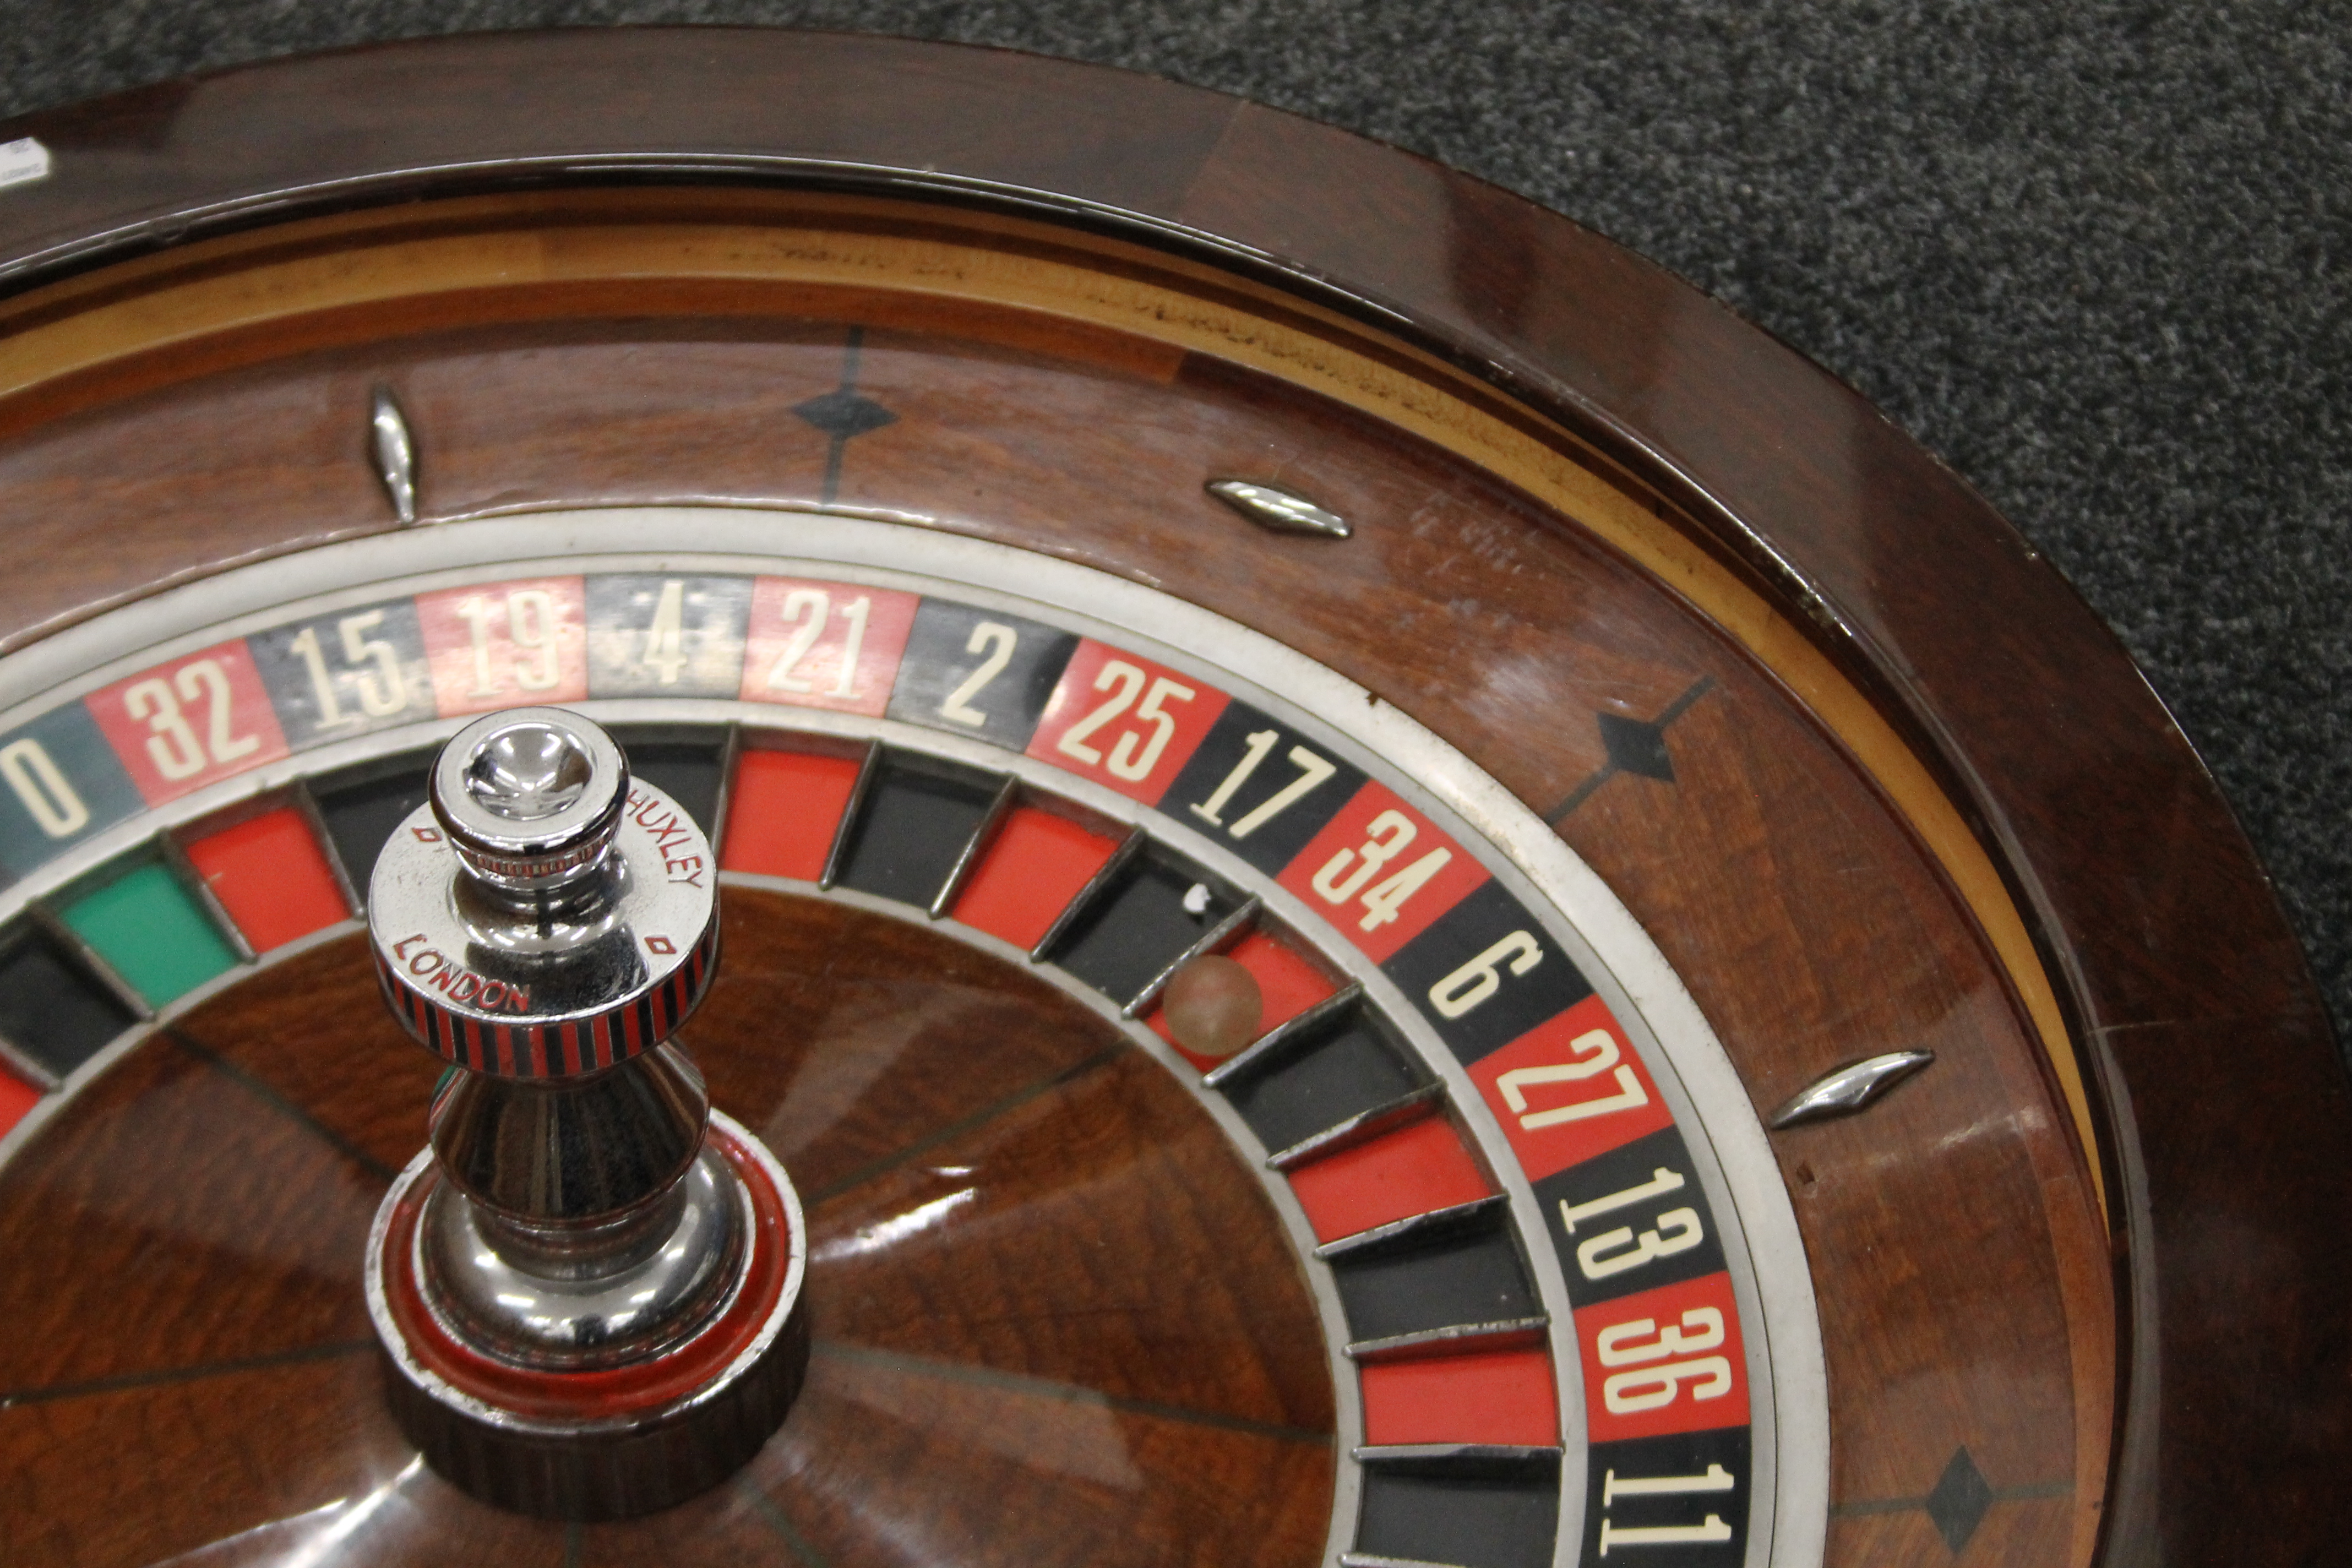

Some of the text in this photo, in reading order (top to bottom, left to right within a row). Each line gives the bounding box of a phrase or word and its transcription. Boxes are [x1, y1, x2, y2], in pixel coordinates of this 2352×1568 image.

[290, 609, 407, 733] 15
[456, 589, 560, 699] 19
[642, 580, 688, 684] 4
[768, 590, 871, 701] 21
[938, 621, 1019, 728] 2
[123, 659, 260, 782] 32
[1057, 660, 1196, 782] 25
[0, 738, 89, 840] 0
[1190, 729, 1337, 839] 17
[625, 788, 704, 890] HUXLEY
[1311, 808, 1452, 933] 34
[393, 933, 530, 1012] LONDON
[1428, 929, 1544, 1019] 6
[1496, 1028, 1649, 1131] 27
[1559, 1167, 1704, 1281] 13
[1597, 1306, 1732, 1415] 36
[1599, 1463, 1735, 1559] 11
